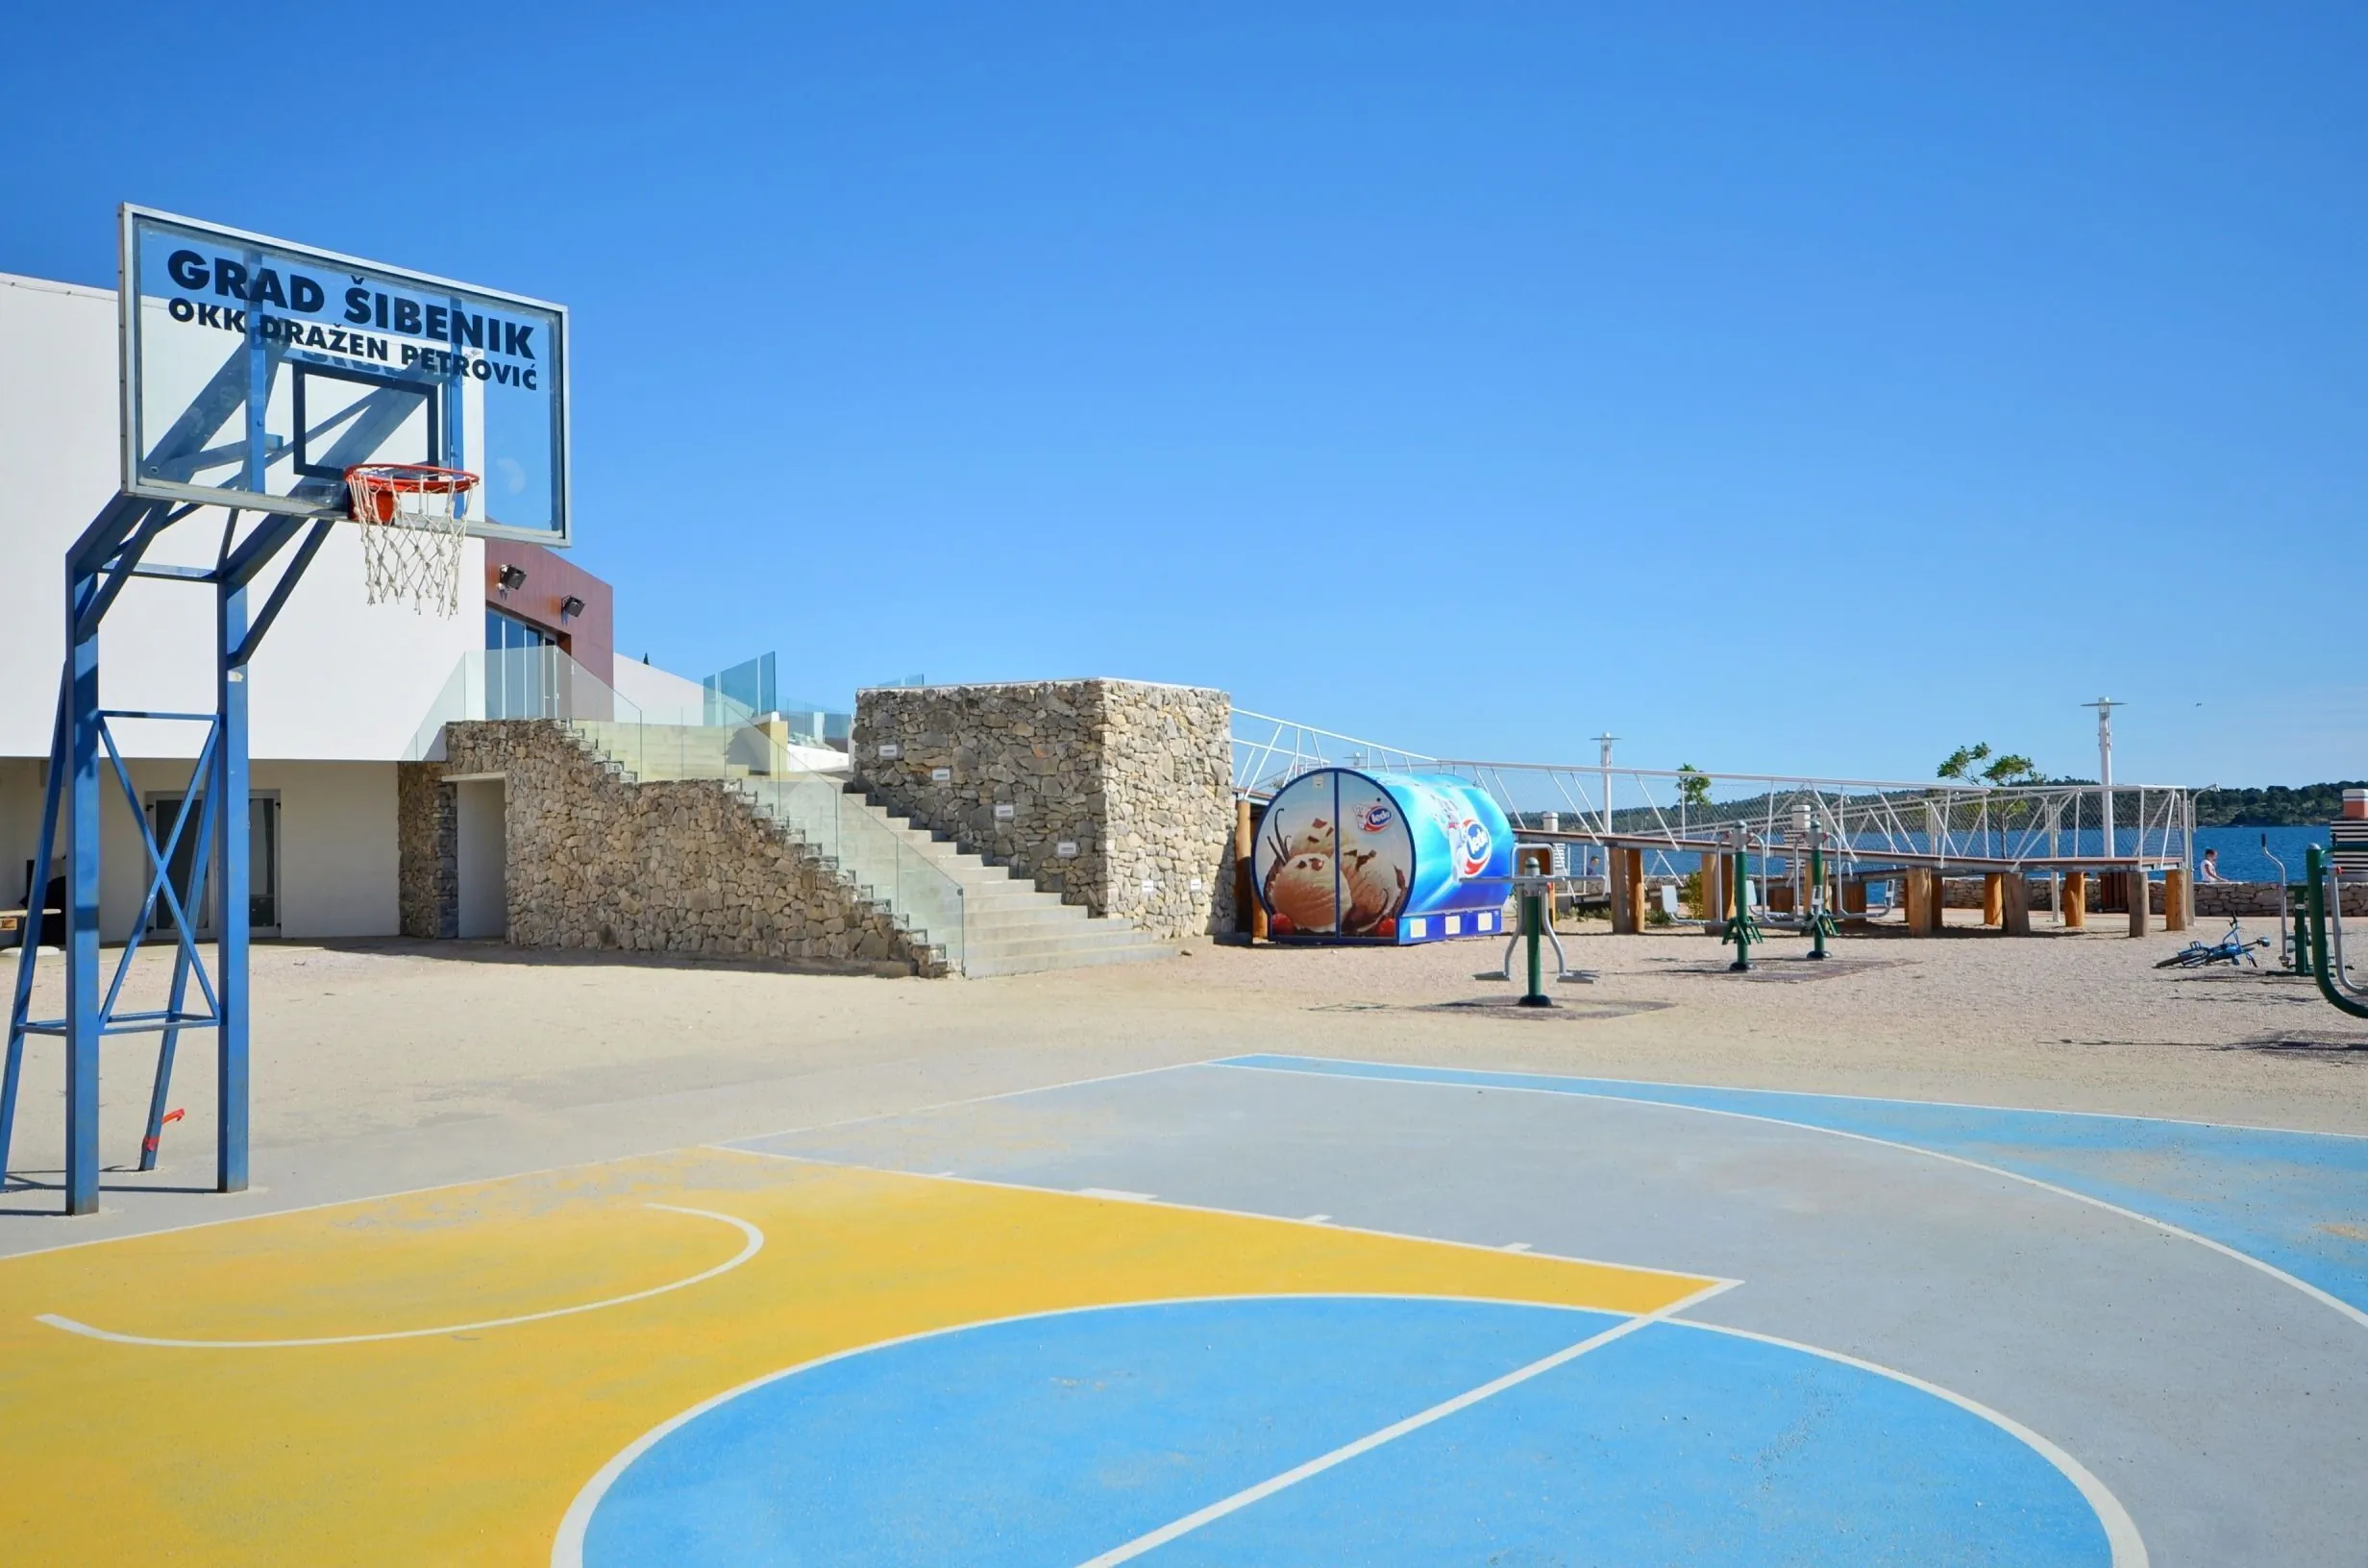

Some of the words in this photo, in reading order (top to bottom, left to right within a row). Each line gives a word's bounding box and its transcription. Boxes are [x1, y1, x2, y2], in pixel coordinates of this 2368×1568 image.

[167, 249, 325, 313] GRAD
[343, 275, 536, 360] ŠIBENIK
[168, 297, 248, 335] OKK
[259, 314, 388, 361] DRAŽEN
[401, 343, 537, 391] PETROVIĆ
